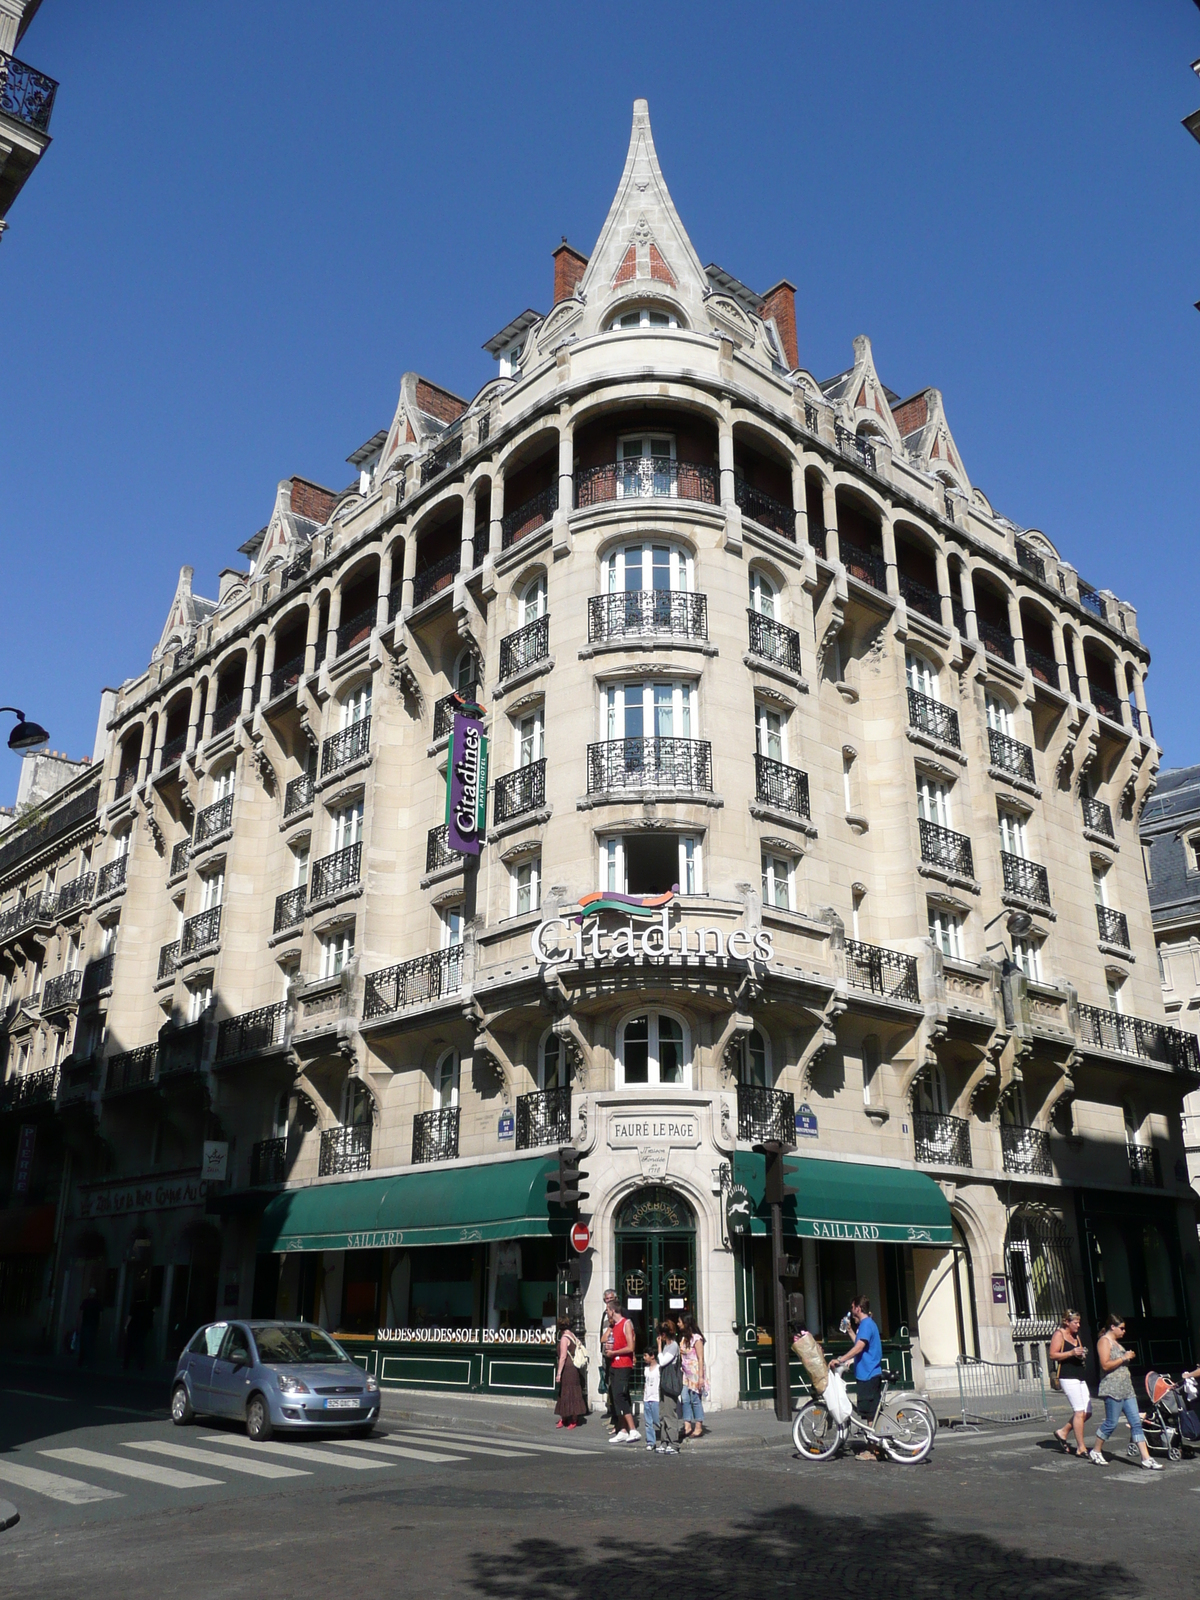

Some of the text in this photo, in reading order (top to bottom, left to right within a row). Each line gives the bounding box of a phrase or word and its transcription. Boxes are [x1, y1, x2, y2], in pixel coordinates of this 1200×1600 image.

[456, 727, 479, 833] Citadines
[479, 757, 487, 809] APART'HOTEL
[531, 908, 774, 963] Citadines
[615, 1121, 693, 1137] FAURÉ LE PAGE
[17, 1128, 35, 1191] PIERRE
[640, 1146, 665, 1154] Maison
[630, 1201, 680, 1228] ARQUEBUSIER
[347, 1231, 404, 1248] SAILLARD
[813, 1222, 880, 1239] SAILLARD
[377, 1328, 412, 1341] SOLDES
[416, 1328, 452, 1342] SOLDES
[499, 1328, 541, 1344] SOLDES
